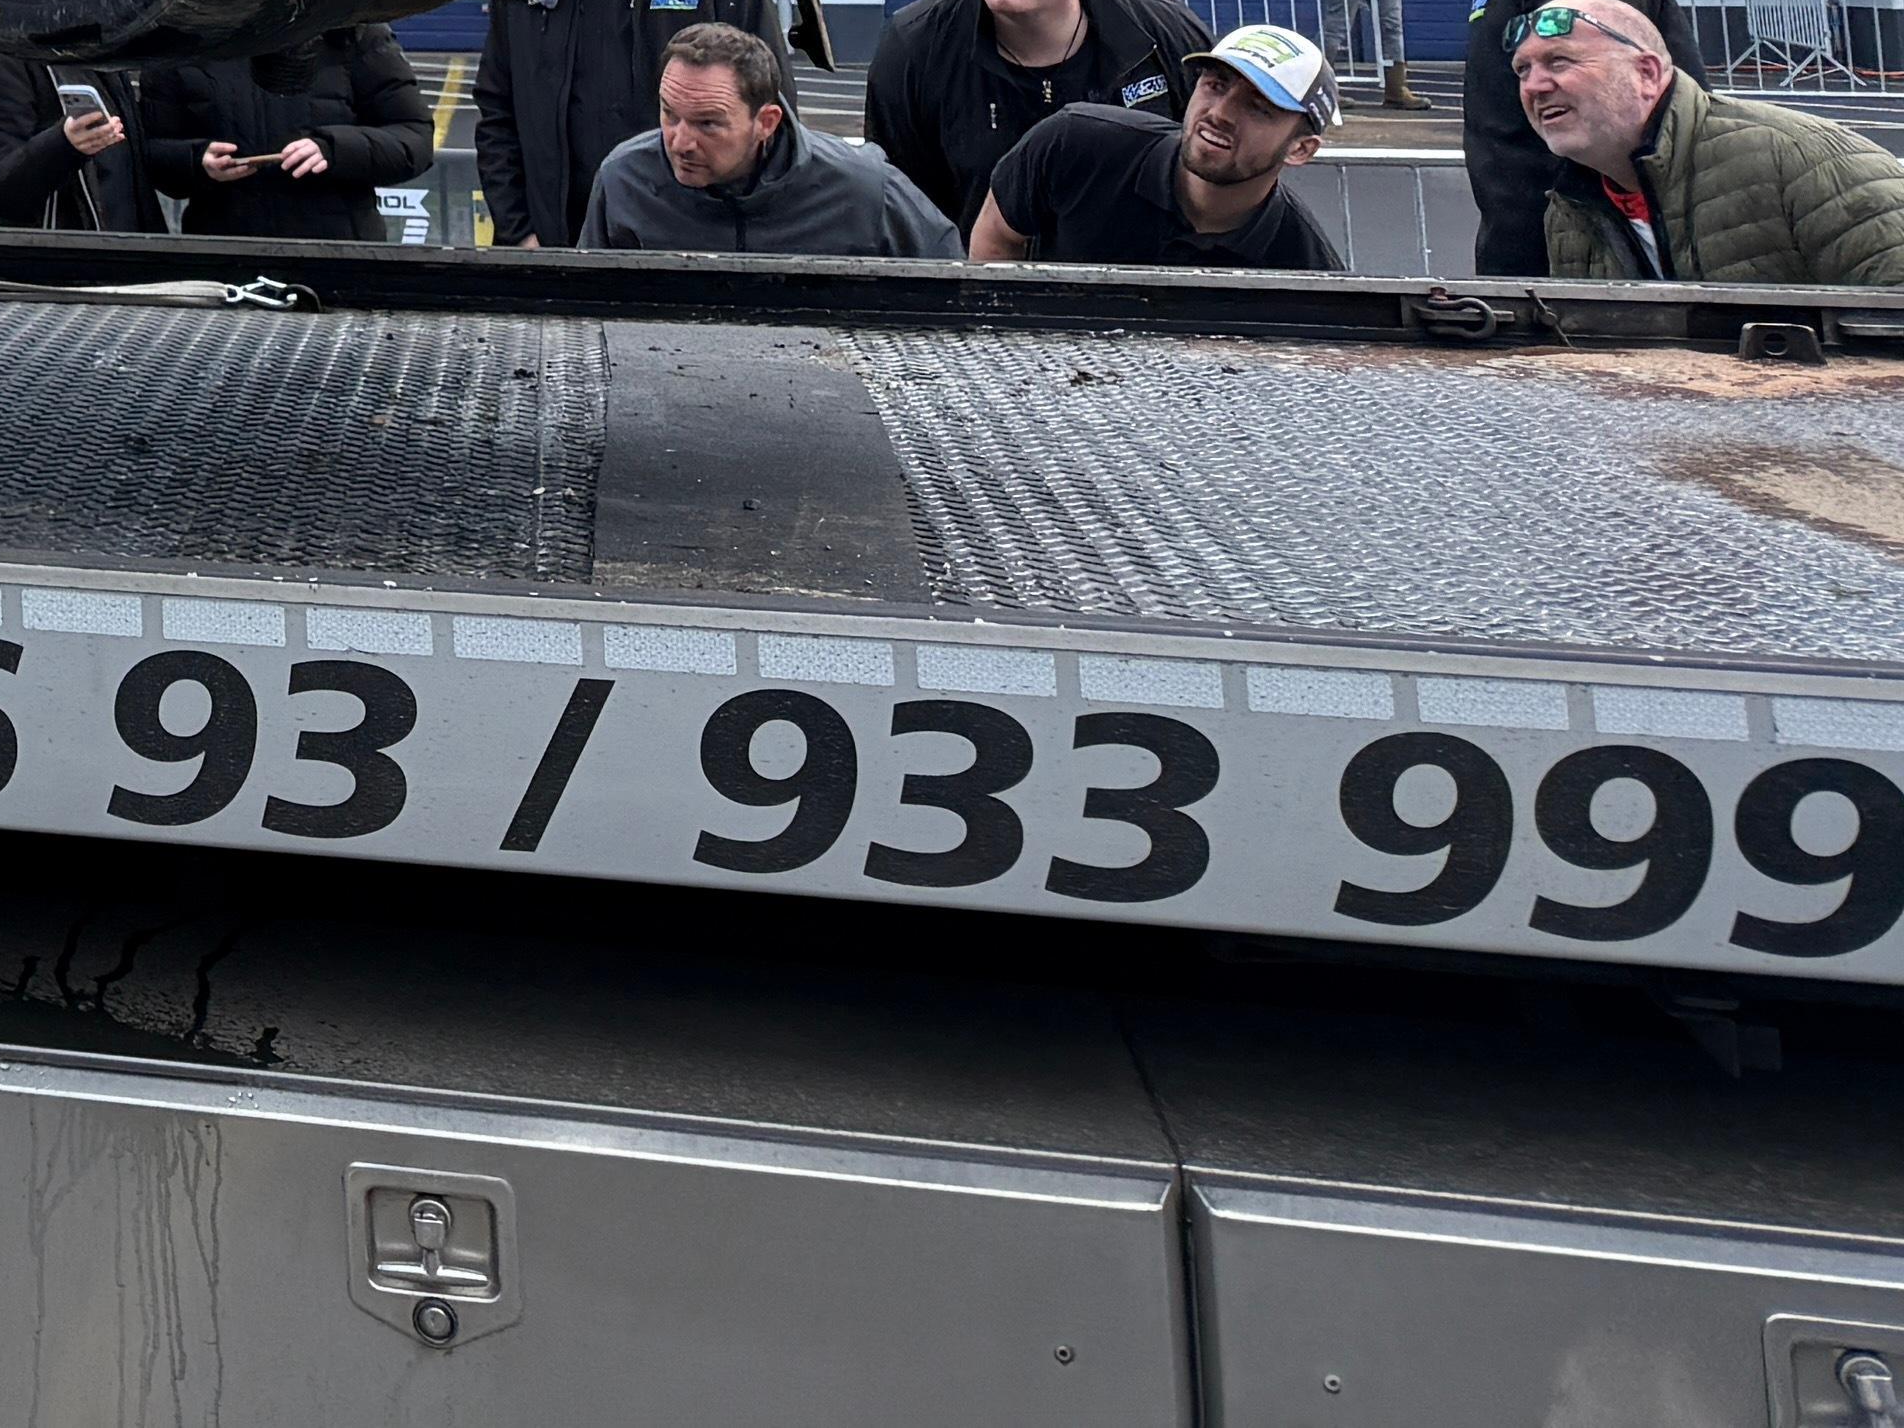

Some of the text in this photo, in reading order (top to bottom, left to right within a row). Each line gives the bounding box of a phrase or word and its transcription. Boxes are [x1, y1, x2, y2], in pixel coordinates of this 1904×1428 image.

[107, 649, 420, 842] 93
[500, 678, 616, 855] /
[692, 687, 1221, 907] 933
[1333, 730, 1904, 962] 999
